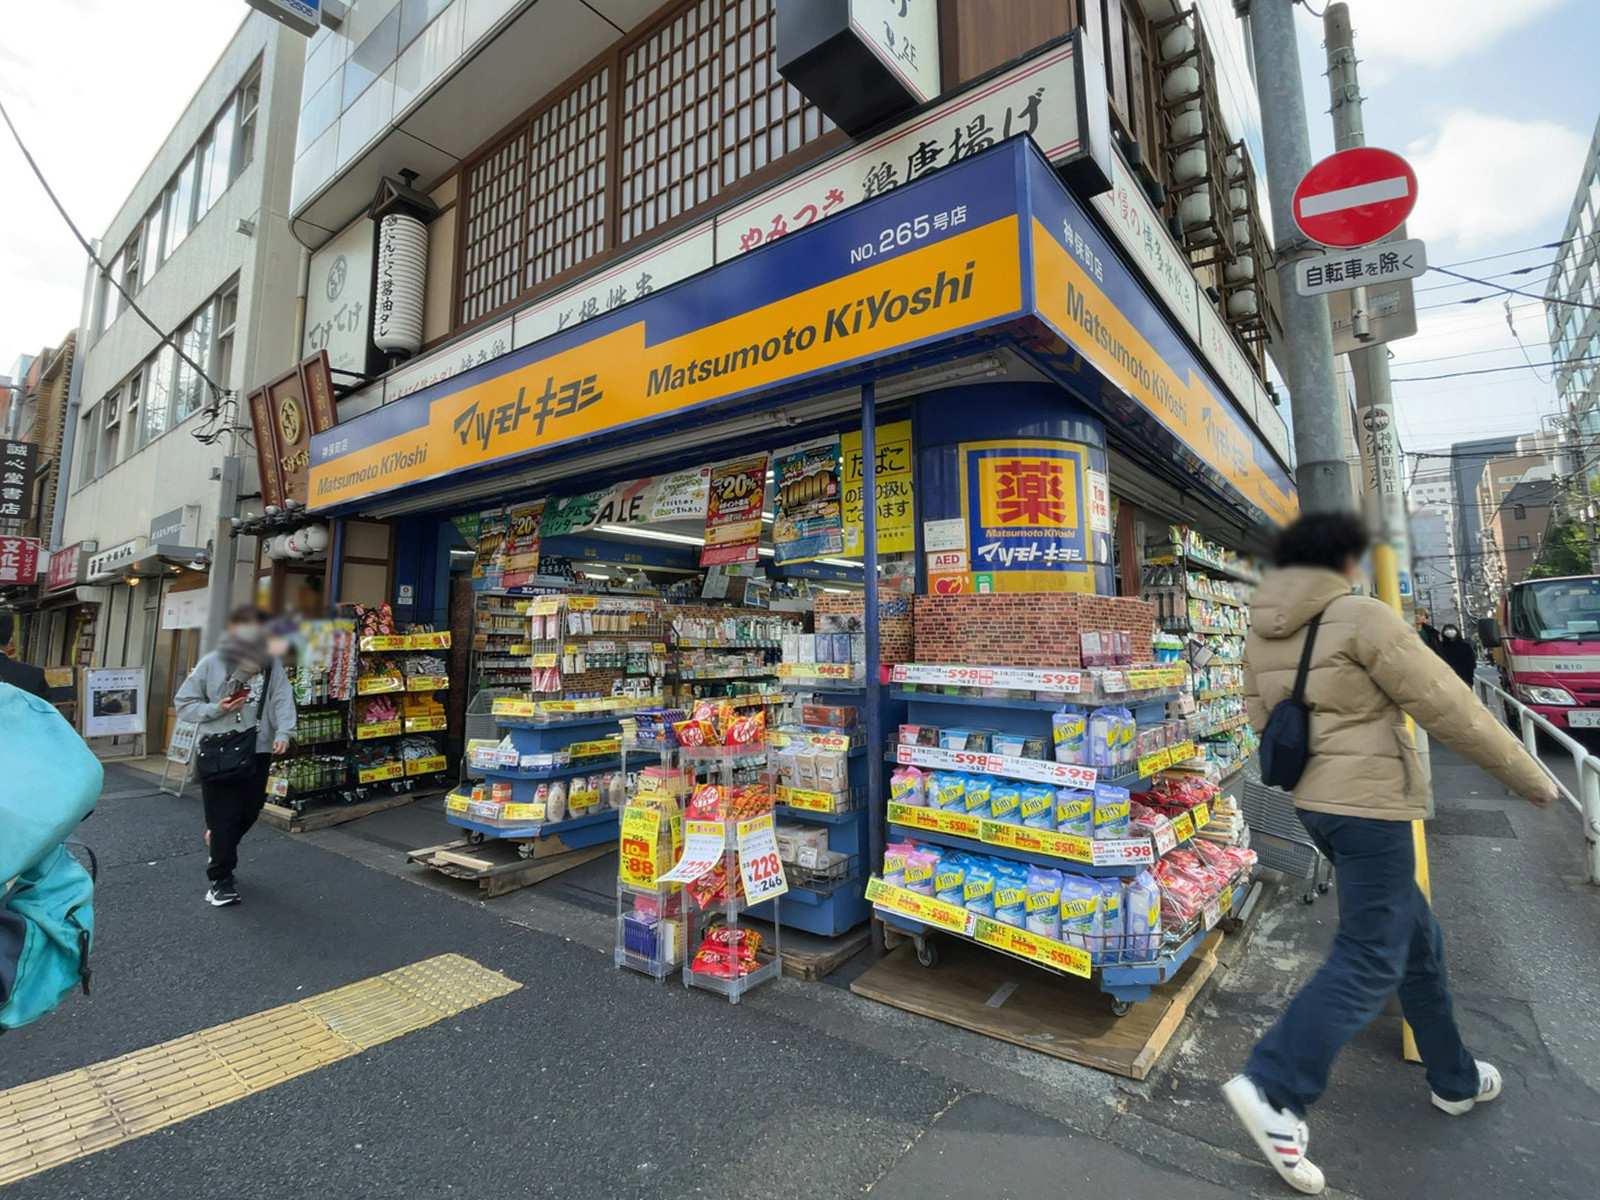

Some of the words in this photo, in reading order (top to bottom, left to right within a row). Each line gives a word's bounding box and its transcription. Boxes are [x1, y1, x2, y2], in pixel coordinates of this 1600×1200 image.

[903, 36, 917, 61] 2F
[1062, 217, 1104, 284] 神保町店
[1306, 251, 1415, 287] 自転車を除く
[645, 324, 817, 398] Matsumoto
[822, 260, 976, 343] KiYoshi
[1066, 280, 1151, 390] Matsumoto
[1151, 369, 1188, 427] KiYoshi
[453, 374, 604, 451] マツモトキヨシ
[317, 461, 379, 496] Matsumoto
[380, 442, 428, 475] KiYoshi
[0, 443, 28, 515] 誠心堂書店
[994, 460, 1067, 524] 薬
[583, 495, 644, 527] SALE
[985, 529, 1044, 539] Matsumoto
[1044, 529, 1076, 539] KiYoshi
[934, 554, 960, 566] AED
[977, 541, 1083, 567] マツモトキヨシ
[949, 669, 979, 679] 598
[1041, 673, 1080, 685] 598
[1057, 724, 1077, 738] Fitty
[955, 753, 987, 766] 598
[1054, 766, 1096, 781] 598
[940, 785, 958, 799] Fitty
[994, 797, 1013, 811] Fitty
[1024, 797, 1044, 812] Fitty
[1061, 802, 1083, 817] Fitty
[1098, 804, 1122, 819] Fitty
[950, 820, 967, 832] 550
[1054, 841, 1076, 854] 550
[1123, 846, 1152, 858] 598
[629, 857, 655, 876] 88
[750, 852, 780, 881] 228
[760, 875, 783, 892] 246
[939, 873, 956, 885] Fitty
[967, 882, 986, 895] Fitty
[998, 890, 1018, 903] Fitty
[1030, 893, 1051, 907] Fitty
[932, 907, 950, 922] 550
[1065, 900, 1089, 916] Fitty
[1050, 949, 1073, 967] 550
